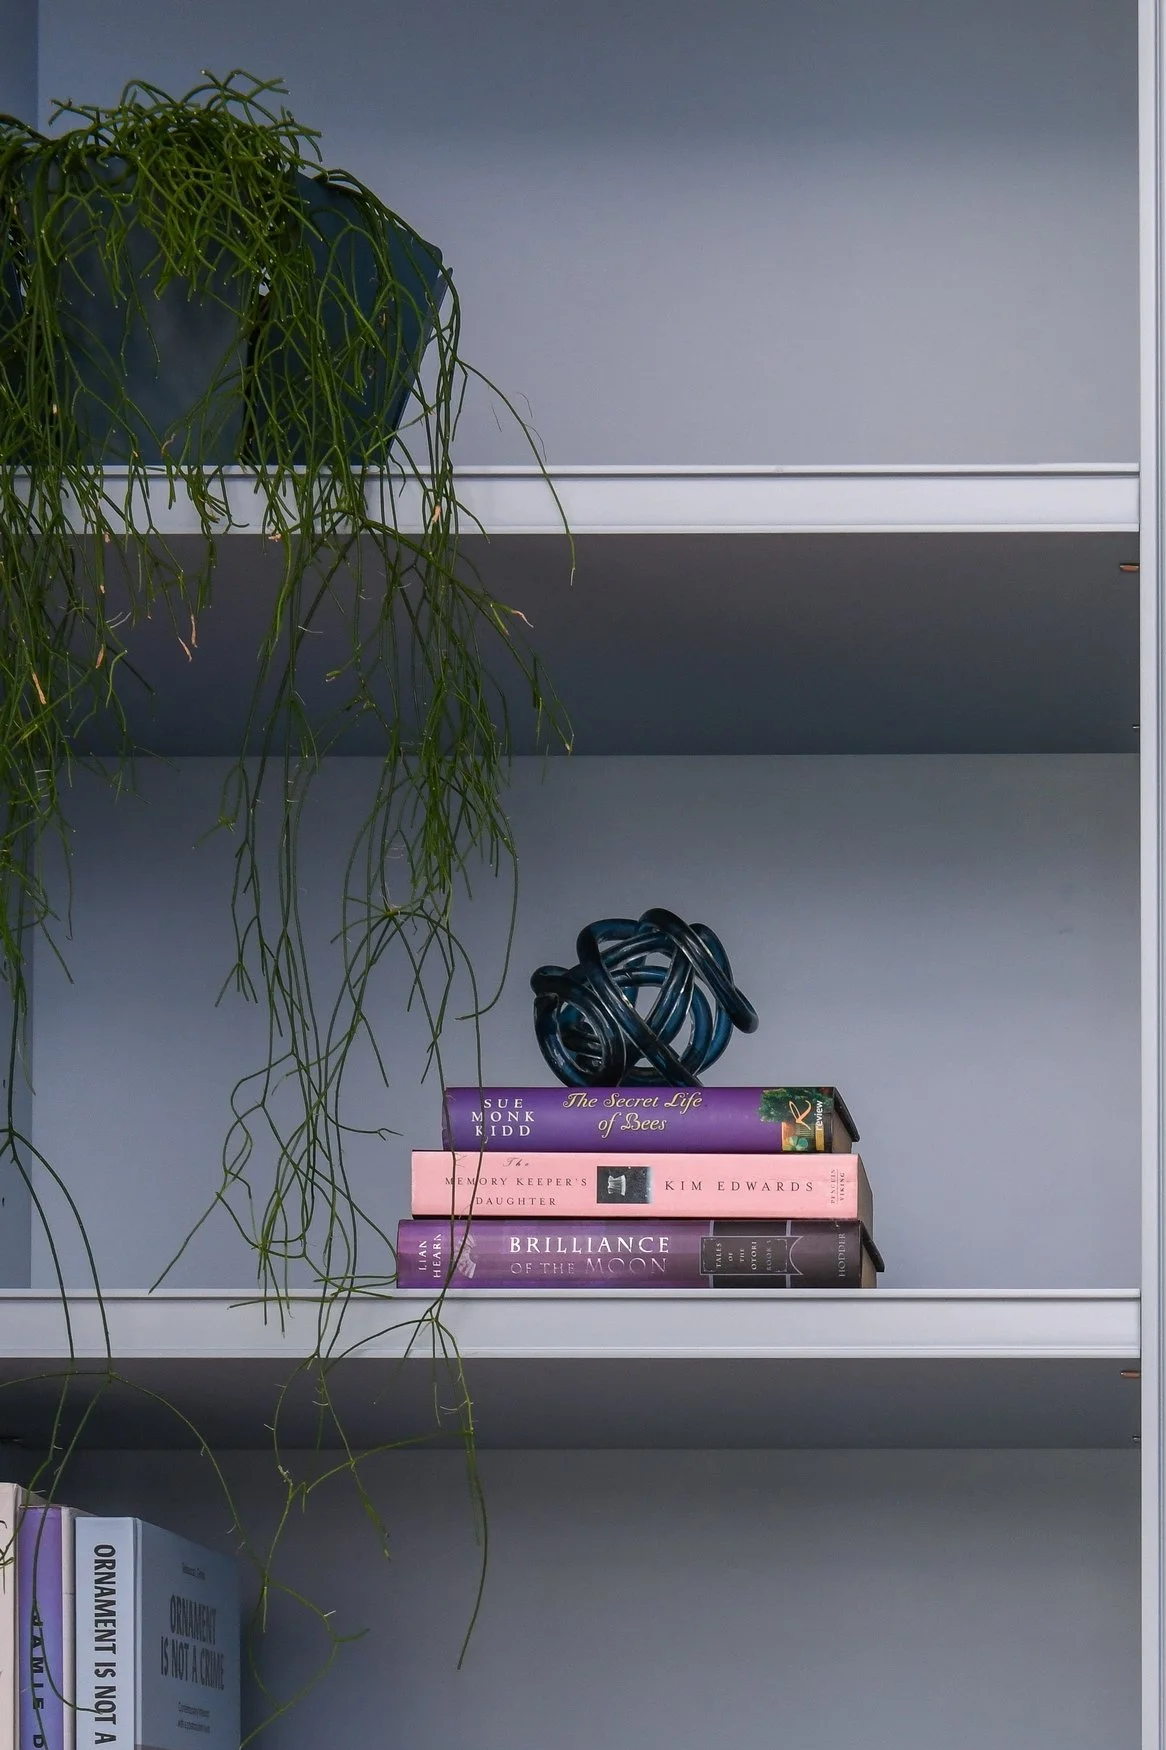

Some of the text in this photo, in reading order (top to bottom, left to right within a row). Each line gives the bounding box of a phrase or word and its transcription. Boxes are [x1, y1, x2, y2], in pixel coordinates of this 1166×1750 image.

[484, 1098, 523, 1109] SUE
[562, 1091, 703, 1115] The Secret Life
[471, 1111, 535, 1122] MONK
[598, 1112, 667, 1139] of Bees
[475, 1125, 531, 1137] KIDD
[445, 1177, 587, 1187] MEMORY KEEPER'S
[665, 1180, 813, 1192] KIM EDWARDS
[475, 1197, 556, 1206] DAUGHTER
[509, 1236, 669, 1254] BRILLIANCE
[419, 1240, 428, 1271] LIAN
[433, 1233, 442, 1278] HEARN
[838, 1232, 846, 1277] HODDER
[510, 1257, 667, 1275] OF THE MOON
[93, 1544, 117, 1655] ORNAMENT
[170, 1594, 216, 1645] ORNAMENT
[94, 1662, 116, 1678] IS
[160, 1636, 225, 1691] IS NOT A CRIME
[94, 1685, 117, 1725] NOT
[94, 1731, 117, 1745] A
